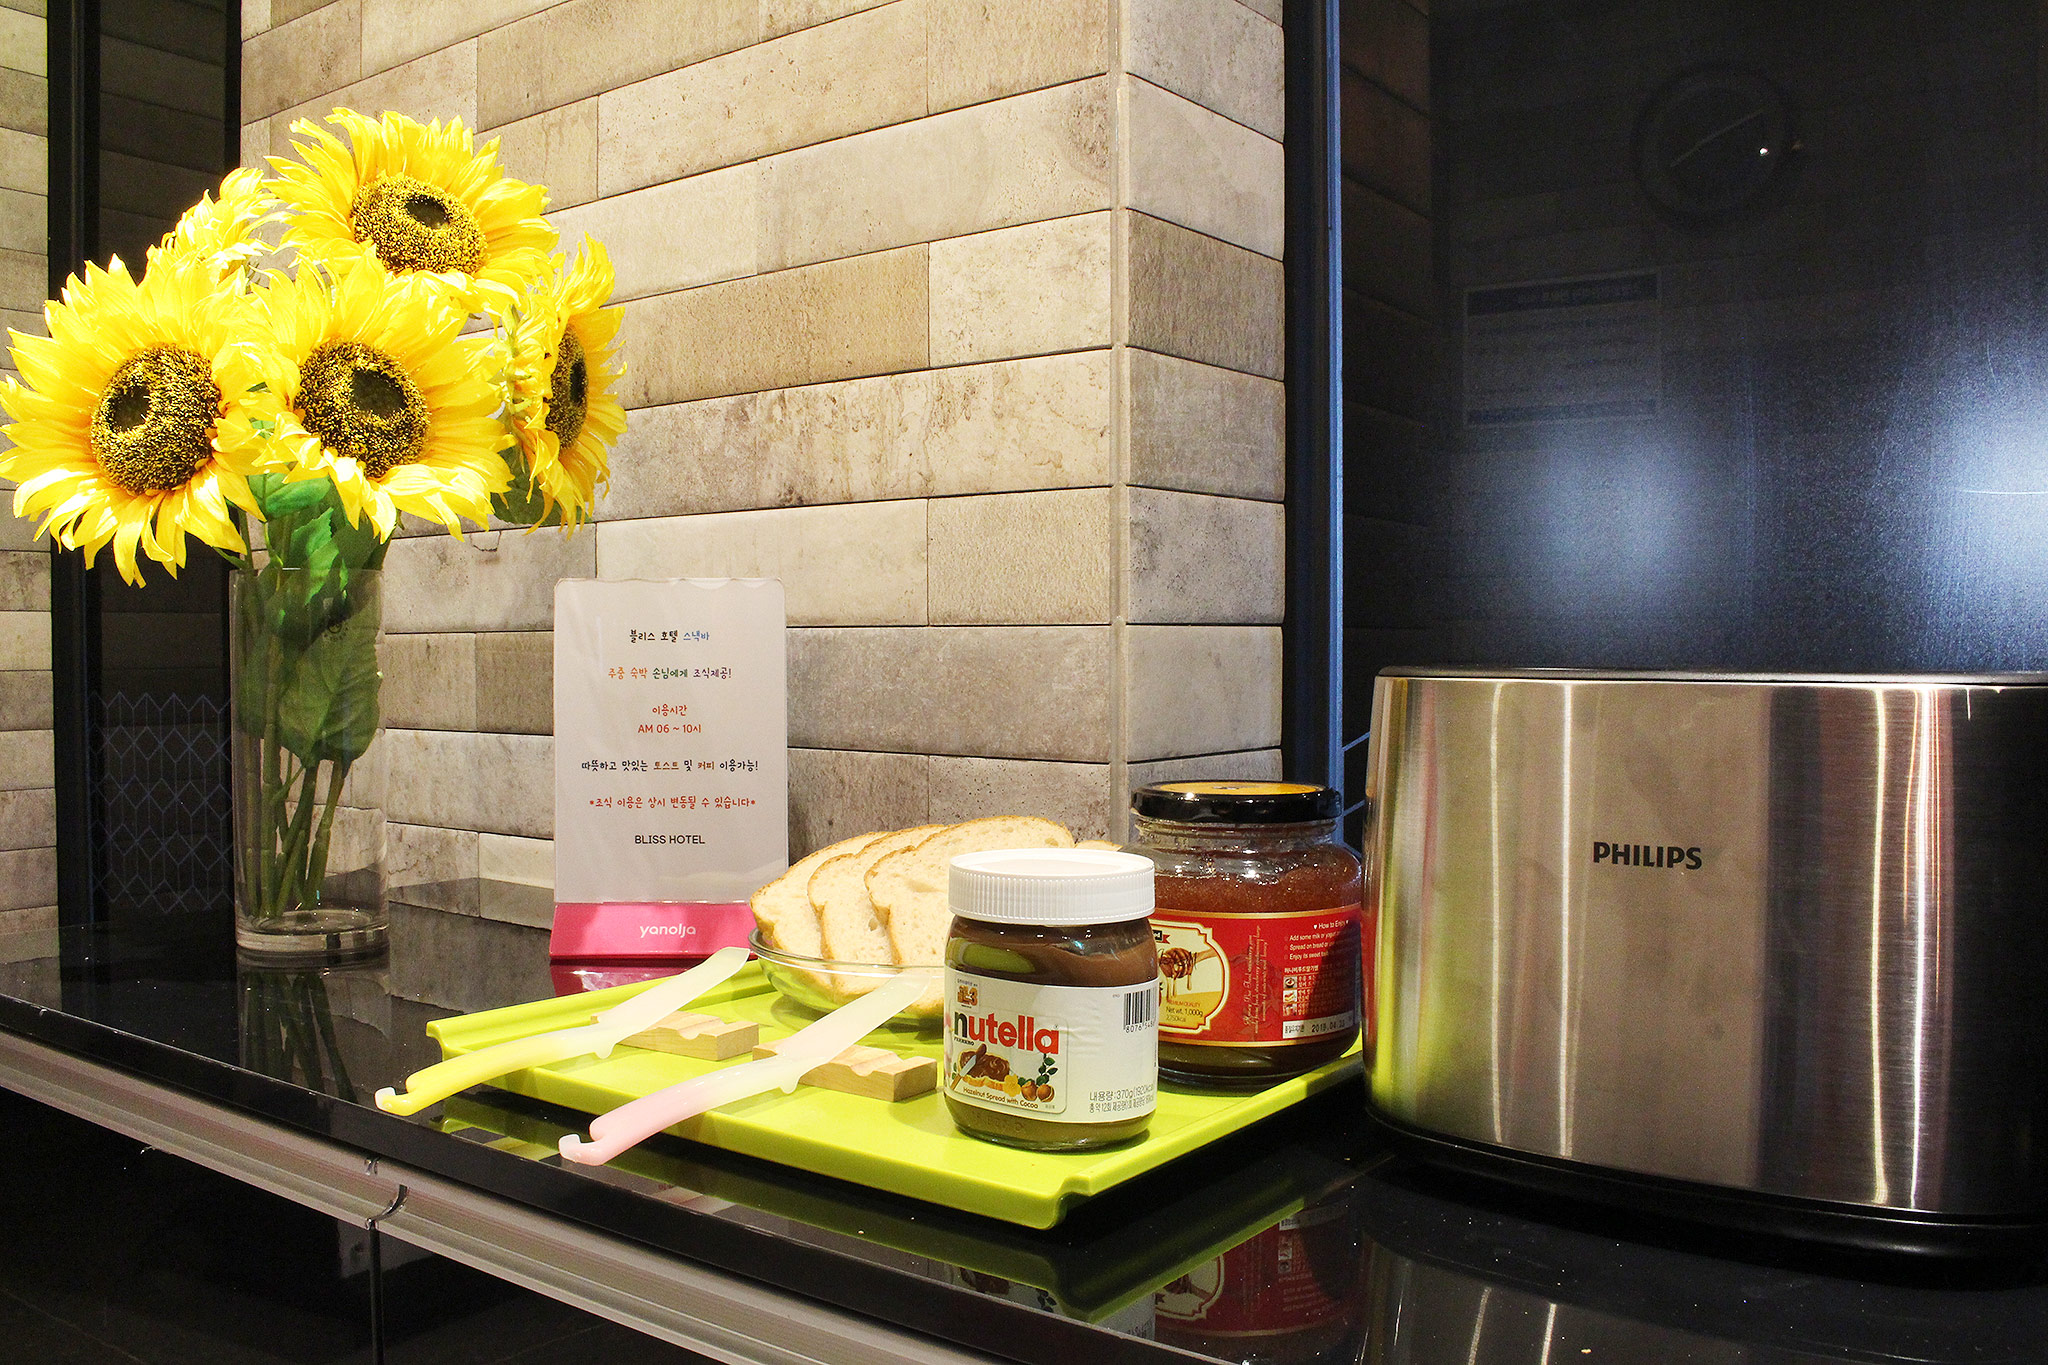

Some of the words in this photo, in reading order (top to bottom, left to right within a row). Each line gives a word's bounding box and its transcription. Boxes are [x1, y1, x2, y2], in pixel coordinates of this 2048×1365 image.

[629, 629, 655, 643] 블리스
[660, 629, 679, 643] 호텔
[683, 630, 710, 642] 스낵바
[608, 667, 625, 680] 주중
[631, 667, 648, 679] 숙박
[652, 667, 688, 680] 손님에게
[693, 667, 732, 680] 조식제공!
[652, 703, 688, 717] 이용시간
[638, 724, 654, 734] AM
[656, 724, 670, 734] 06
[683, 723, 702, 734] 10시
[581, 759, 617, 772] 따뜻하고
[621, 759, 648, 772] 맛있는
[653, 761, 680, 771] 토스트
[683, 760, 693, 772] 및
[697, 761, 715, 771] 커피
[719, 758, 759, 772] 이용가능!
[595, 797, 613, 809] 조식
[617, 796, 643, 809] 이용은
[648, 796, 666, 809] 상시
[670, 796, 697, 810] 변동될
[701, 797, 710, 808] 수
[714, 796, 750, 810] 있습니다
[634, 835, 667, 844] BLISS
[669, 835, 705, 844] HOTEL
[1593, 841, 1702, 870] PHILIPS
[639, 923, 697, 939] yanolja
[954, 1011, 1060, 1054] nutella
[963, 1086, 986, 1098] Hazelnut
[986, 1092, 1006, 1103] Spread
[1006, 1097, 1019, 1105] with
[1019, 1100, 1039, 1109] Cocoa
